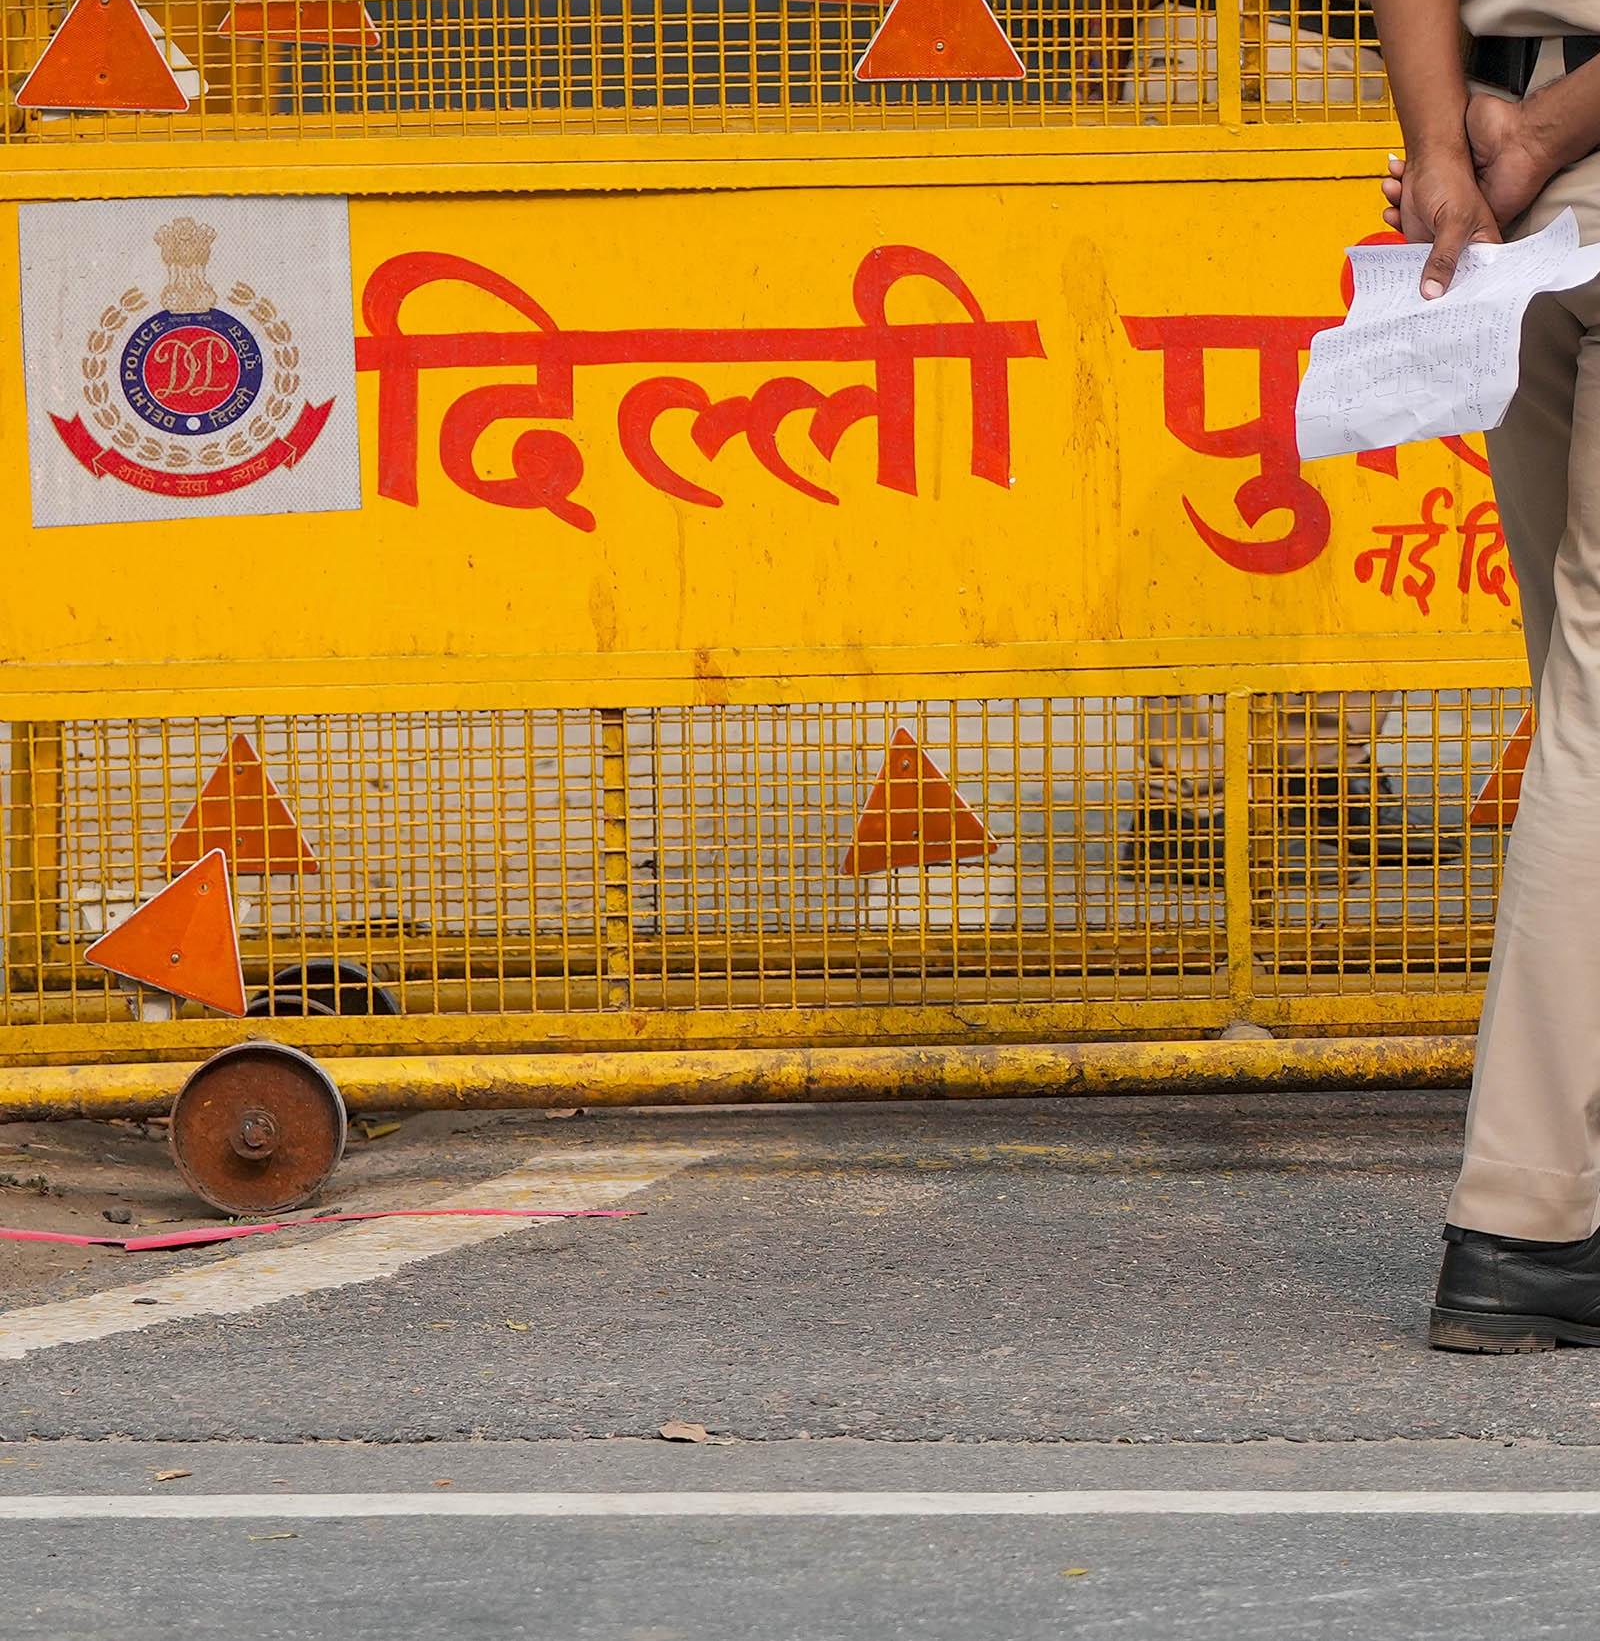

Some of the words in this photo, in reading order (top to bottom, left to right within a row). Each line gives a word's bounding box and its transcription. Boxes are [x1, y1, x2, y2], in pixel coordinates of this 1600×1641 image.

[125, 319, 164, 381] POLICE
[355, 245, 1047, 533] दिल्ली
[129, 386, 176, 428] DELHI
[1354, 487, 1454, 616] नई
